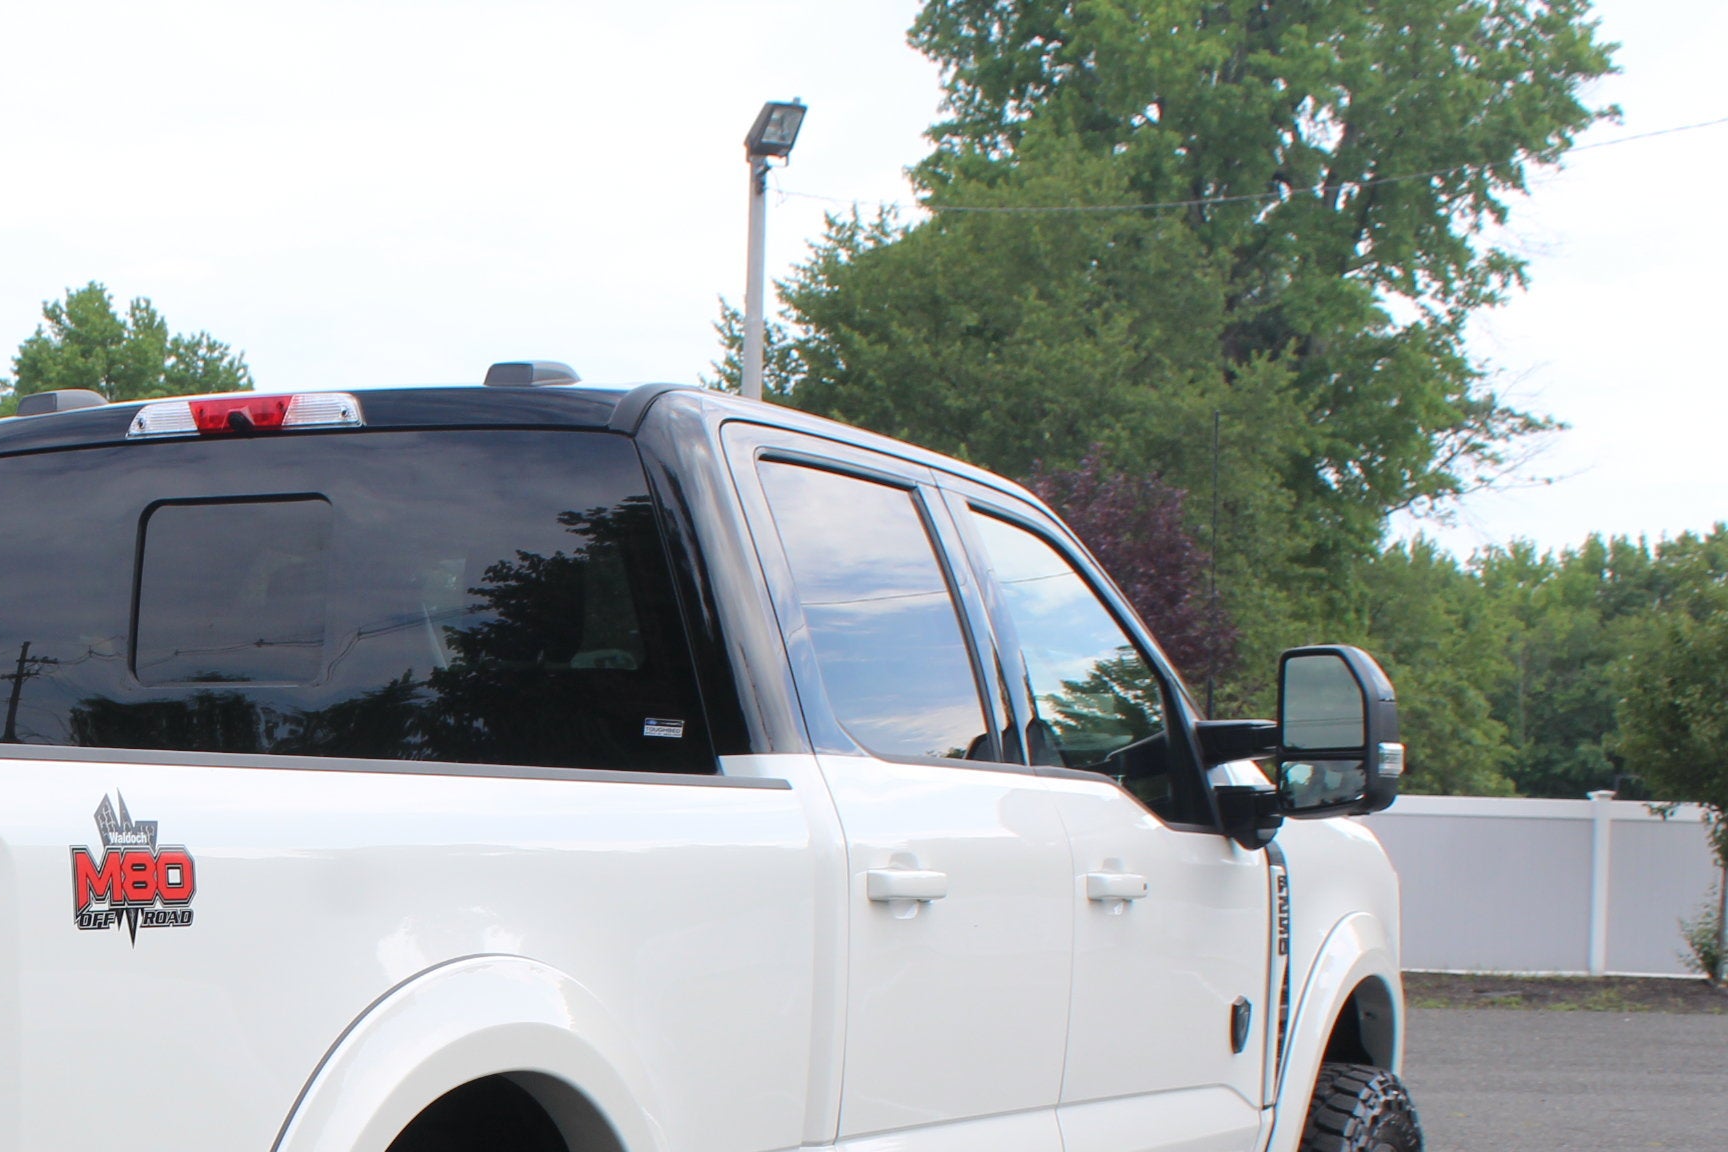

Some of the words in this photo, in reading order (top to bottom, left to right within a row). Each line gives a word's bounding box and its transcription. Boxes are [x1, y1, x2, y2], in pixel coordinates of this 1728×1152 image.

[108, 831, 148, 844] Waldoch
[70, 846, 197, 914] M80
[77, 910, 117, 930] OFF
[141, 909, 194, 926] ROAD
